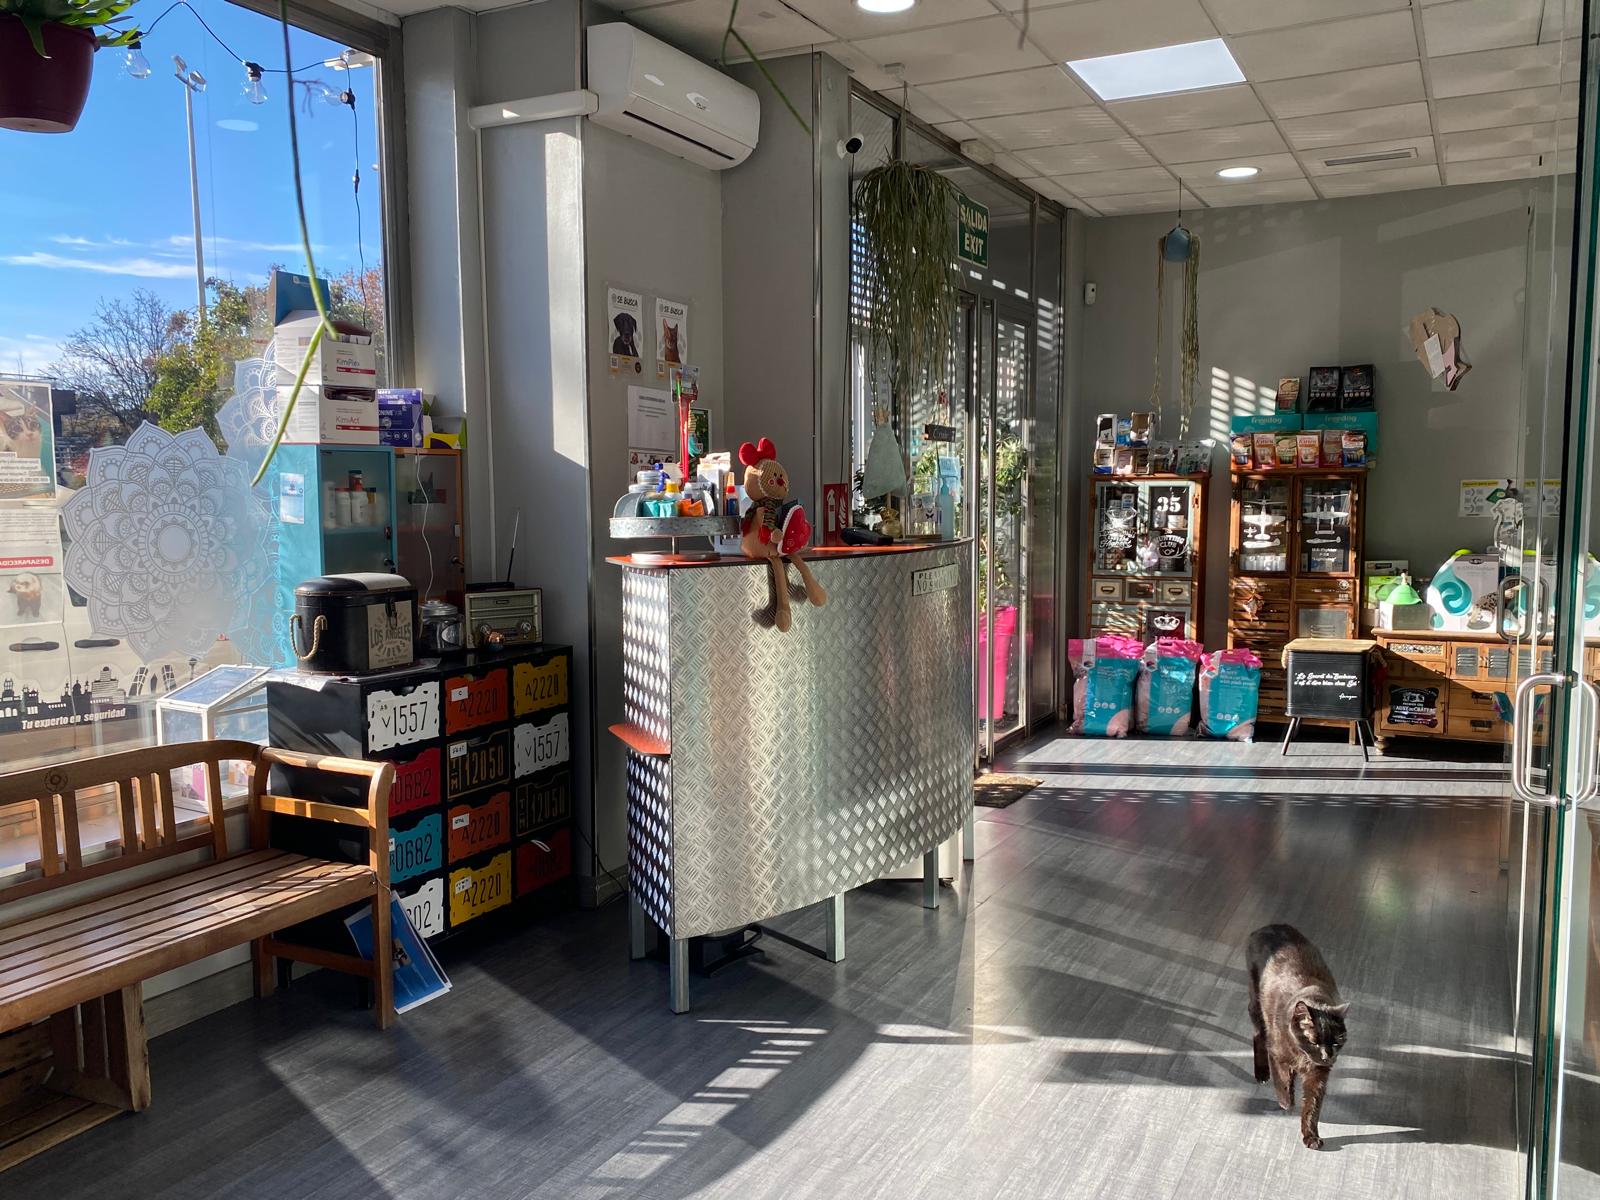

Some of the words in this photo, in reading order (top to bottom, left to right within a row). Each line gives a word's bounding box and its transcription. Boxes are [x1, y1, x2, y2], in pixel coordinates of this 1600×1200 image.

[960, 204, 988, 232] SALIDA
[964, 232, 983, 256] EXIT
[624, 297, 638, 306] BUSCA
[670, 307, 684, 315] BUSCA
[1157, 497, 1180, 512] 35
[370, 627, 384, 649] LOS
[385, 622, 412, 642] ANGELES
[22, 720, 33, 730] Tu
[34, 716, 68, 728] experto
[70, 715, 81, 724] en
[84, 708, 126, 722] seguridad
[465, 745, 504, 786] 12050
[462, 872, 501, 908] A2220
